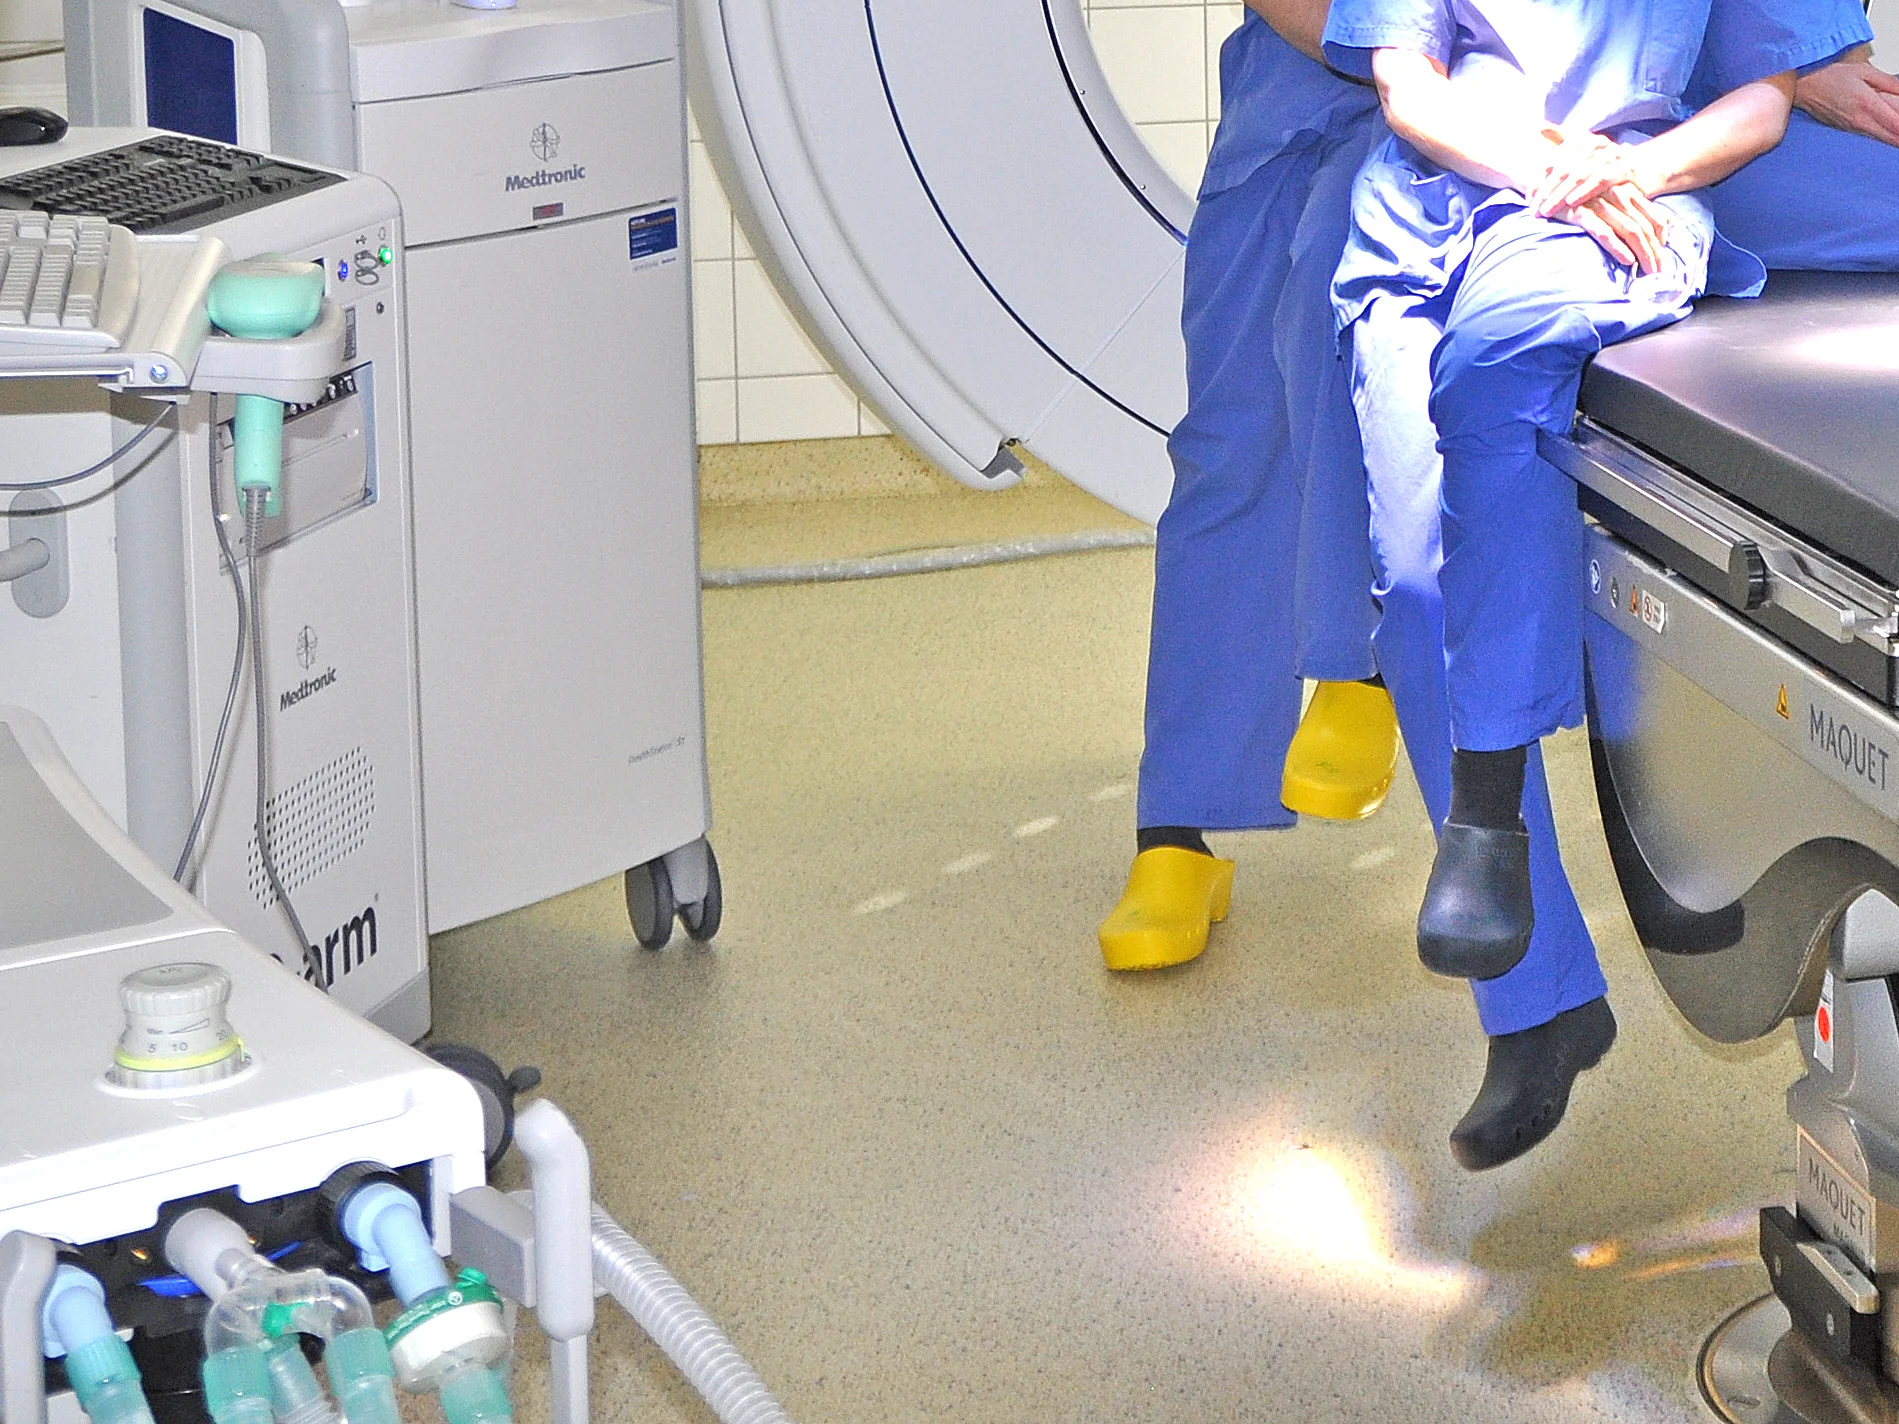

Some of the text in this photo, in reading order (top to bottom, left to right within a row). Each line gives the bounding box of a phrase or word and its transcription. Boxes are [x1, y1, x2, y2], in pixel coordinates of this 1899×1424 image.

[505, 164, 586, 193] Medtronic
[280, 666, 337, 712] Medtronic
[1809, 703, 1889, 791] MAQUET
[270, 907, 377, 988] arm
[147, 1042, 188, 1053] 5 10
[1809, 1158, 1867, 1236] MAQUET
